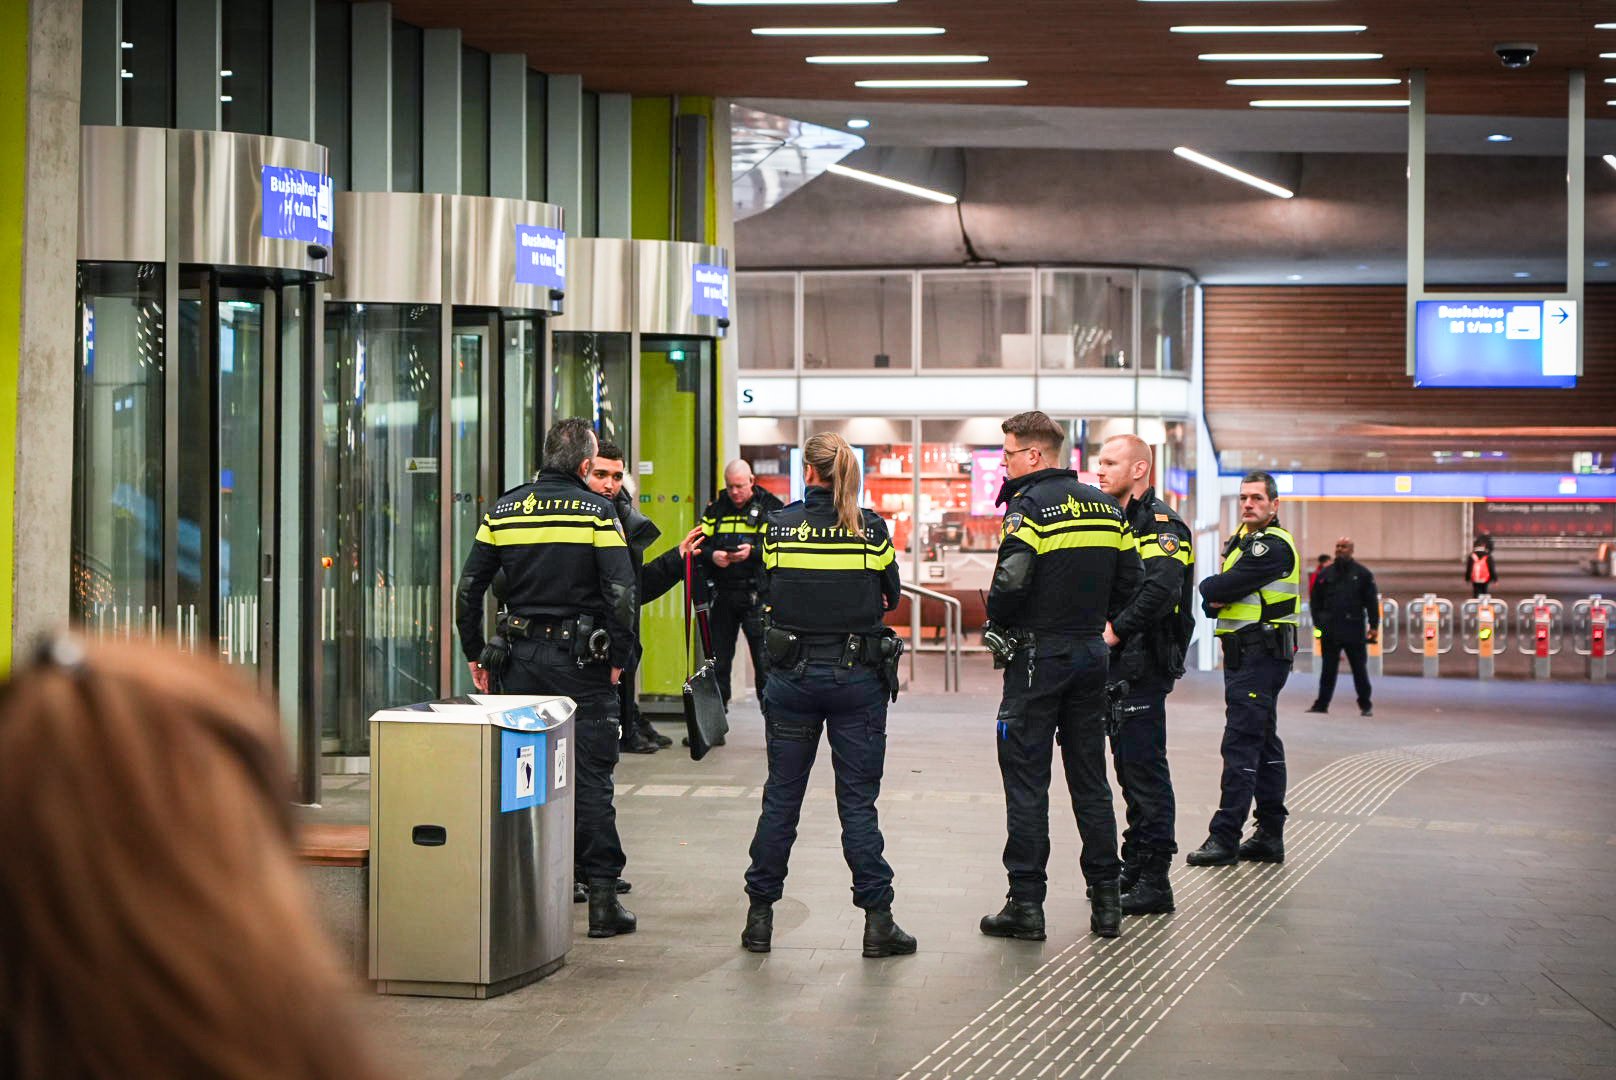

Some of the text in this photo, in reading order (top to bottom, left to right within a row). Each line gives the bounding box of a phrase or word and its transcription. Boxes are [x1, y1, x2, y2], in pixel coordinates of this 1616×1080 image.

[270, 175, 316, 197] Bushaltes
[284, 199, 292, 215] H
[294, 201, 311, 217] t/m
[513, 493, 582, 514] POLITIE
[1060, 494, 1113, 518] POLITIE
[790, 520, 855, 541] POLITIE
